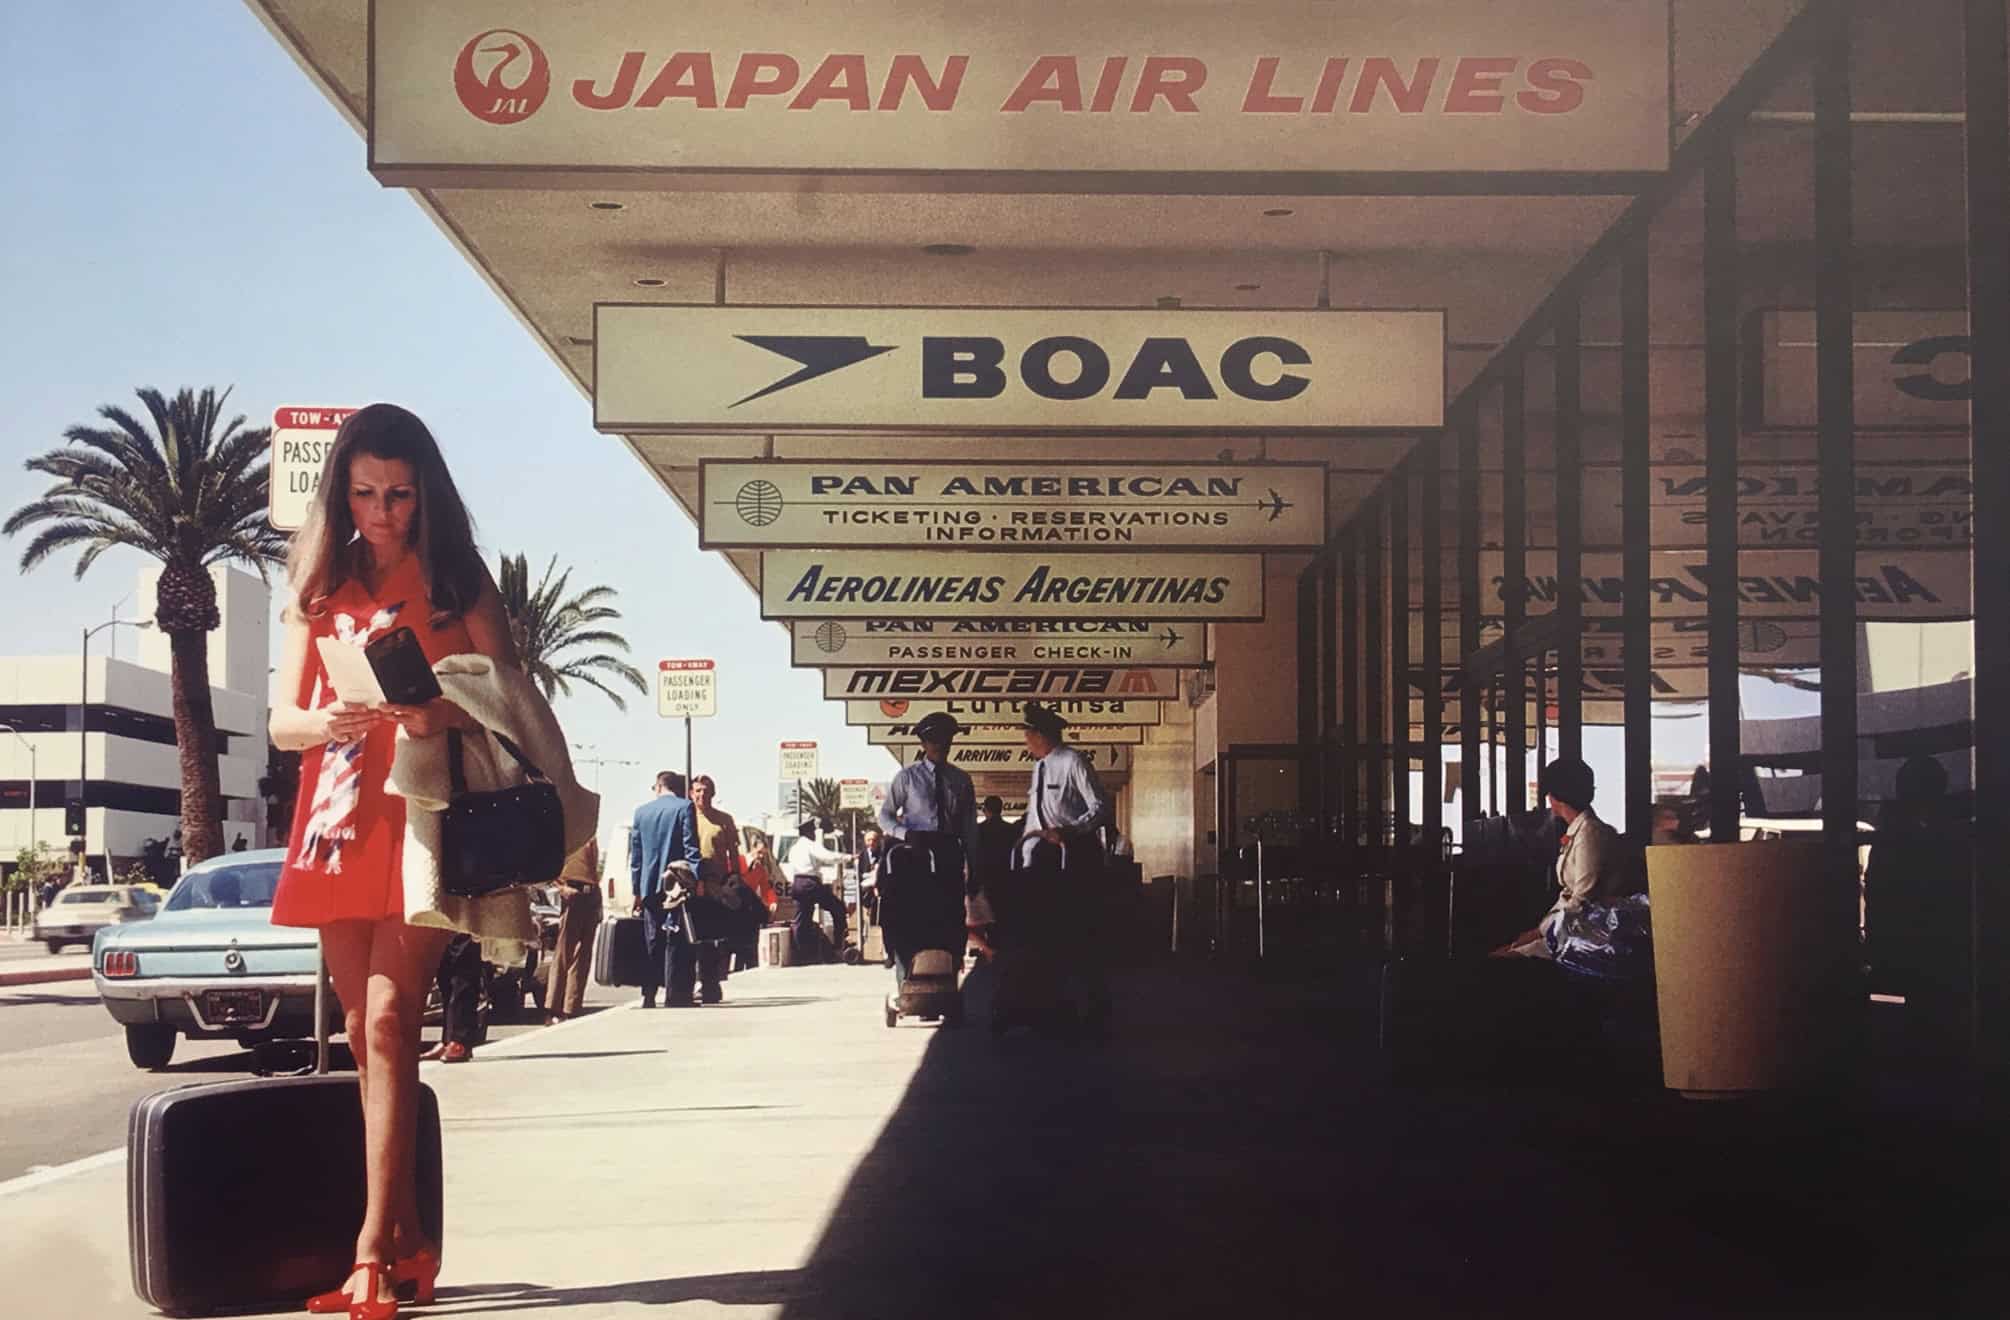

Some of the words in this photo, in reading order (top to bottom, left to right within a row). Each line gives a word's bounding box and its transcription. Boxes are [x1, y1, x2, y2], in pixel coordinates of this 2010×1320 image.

[572, 52, 969, 111] JAPAN
[1000, 56, 1208, 114] AIR
[1241, 57, 1594, 114] LINES
[922, 336, 1312, 401] BOAC
[811, 476, 919, 496] PAN
[940, 476, 1243, 496] AMERICAN
[823, 510, 982, 525] TICKETING
[1011, 511, 1230, 526] RESERVATIONS
[926, 526, 1134, 542] INFORMATION
[787, 564, 1006, 603] AEROLINEAS
[1014, 565, 1230, 603] ARGENTINAS
[866, 622, 934, 633] PAN
[951, 622, 1150, 633] AMERICAN
[889, 646, 1016, 659] PASSENGER
[1033, 646, 1132, 659] CHECK-IN
[947, 699, 1124, 713] Luftansa
[954, 749, 1012, 762] ARRIVING
